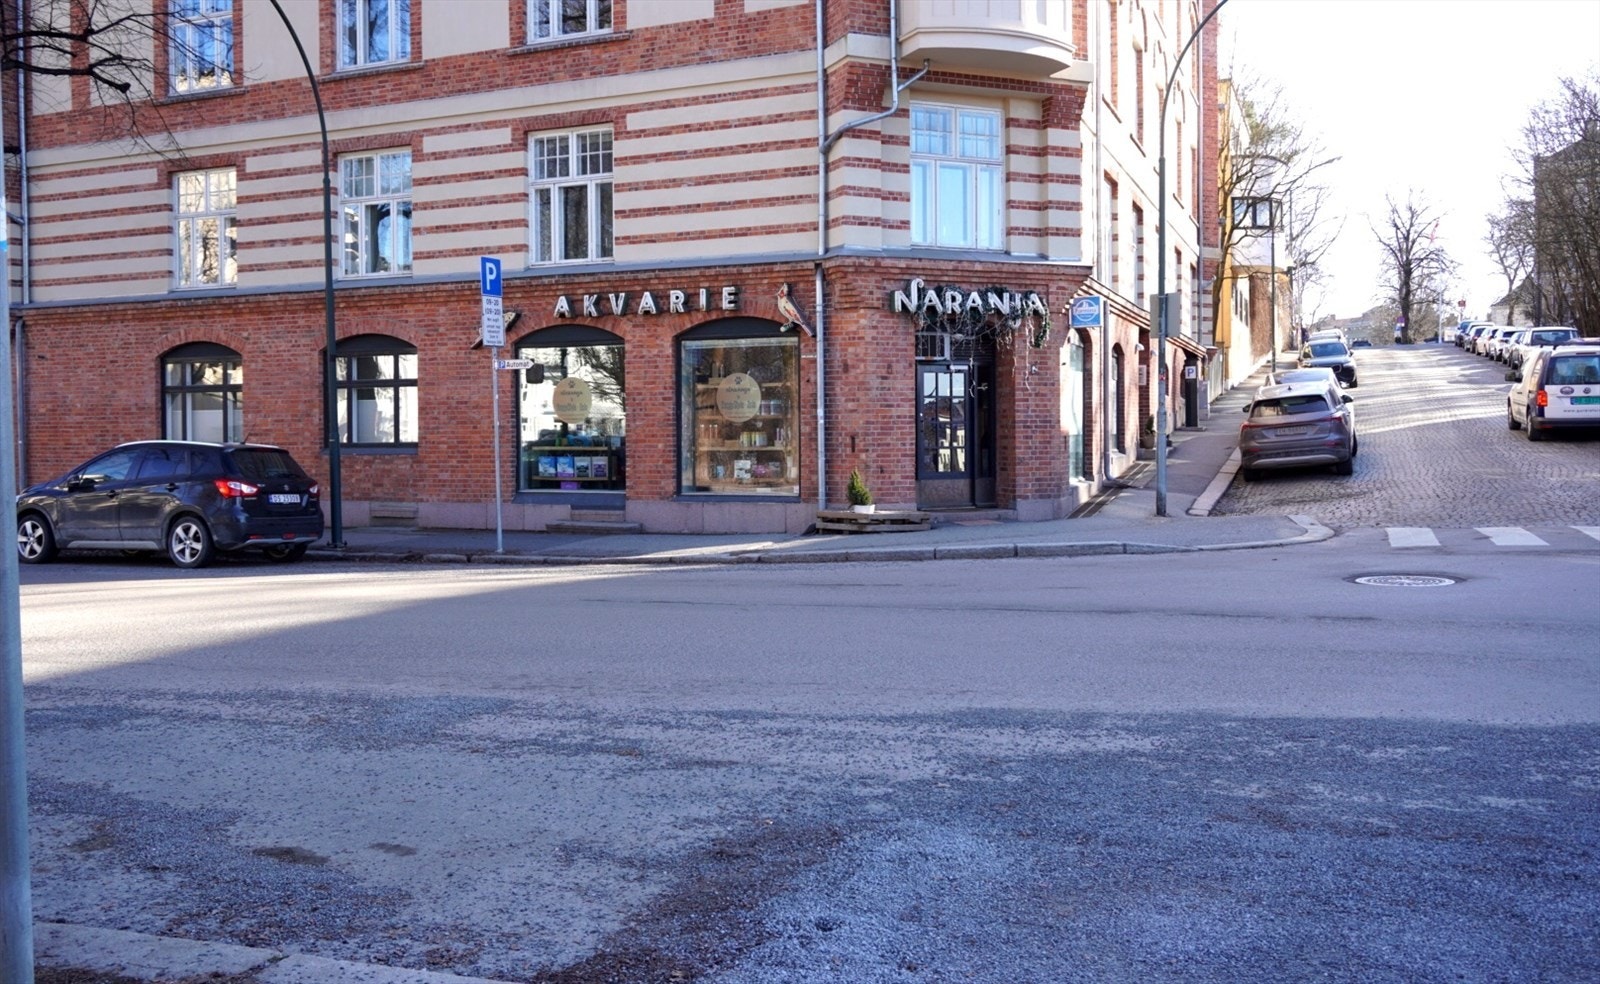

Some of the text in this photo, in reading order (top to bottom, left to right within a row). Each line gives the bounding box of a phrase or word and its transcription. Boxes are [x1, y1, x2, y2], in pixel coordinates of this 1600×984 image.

[485, 262, 497, 291] P
[553, 286, 737, 318] AKVARIE
[894, 278, 1046, 329] NARANJA
[1187, 368, 1195, 377] P
